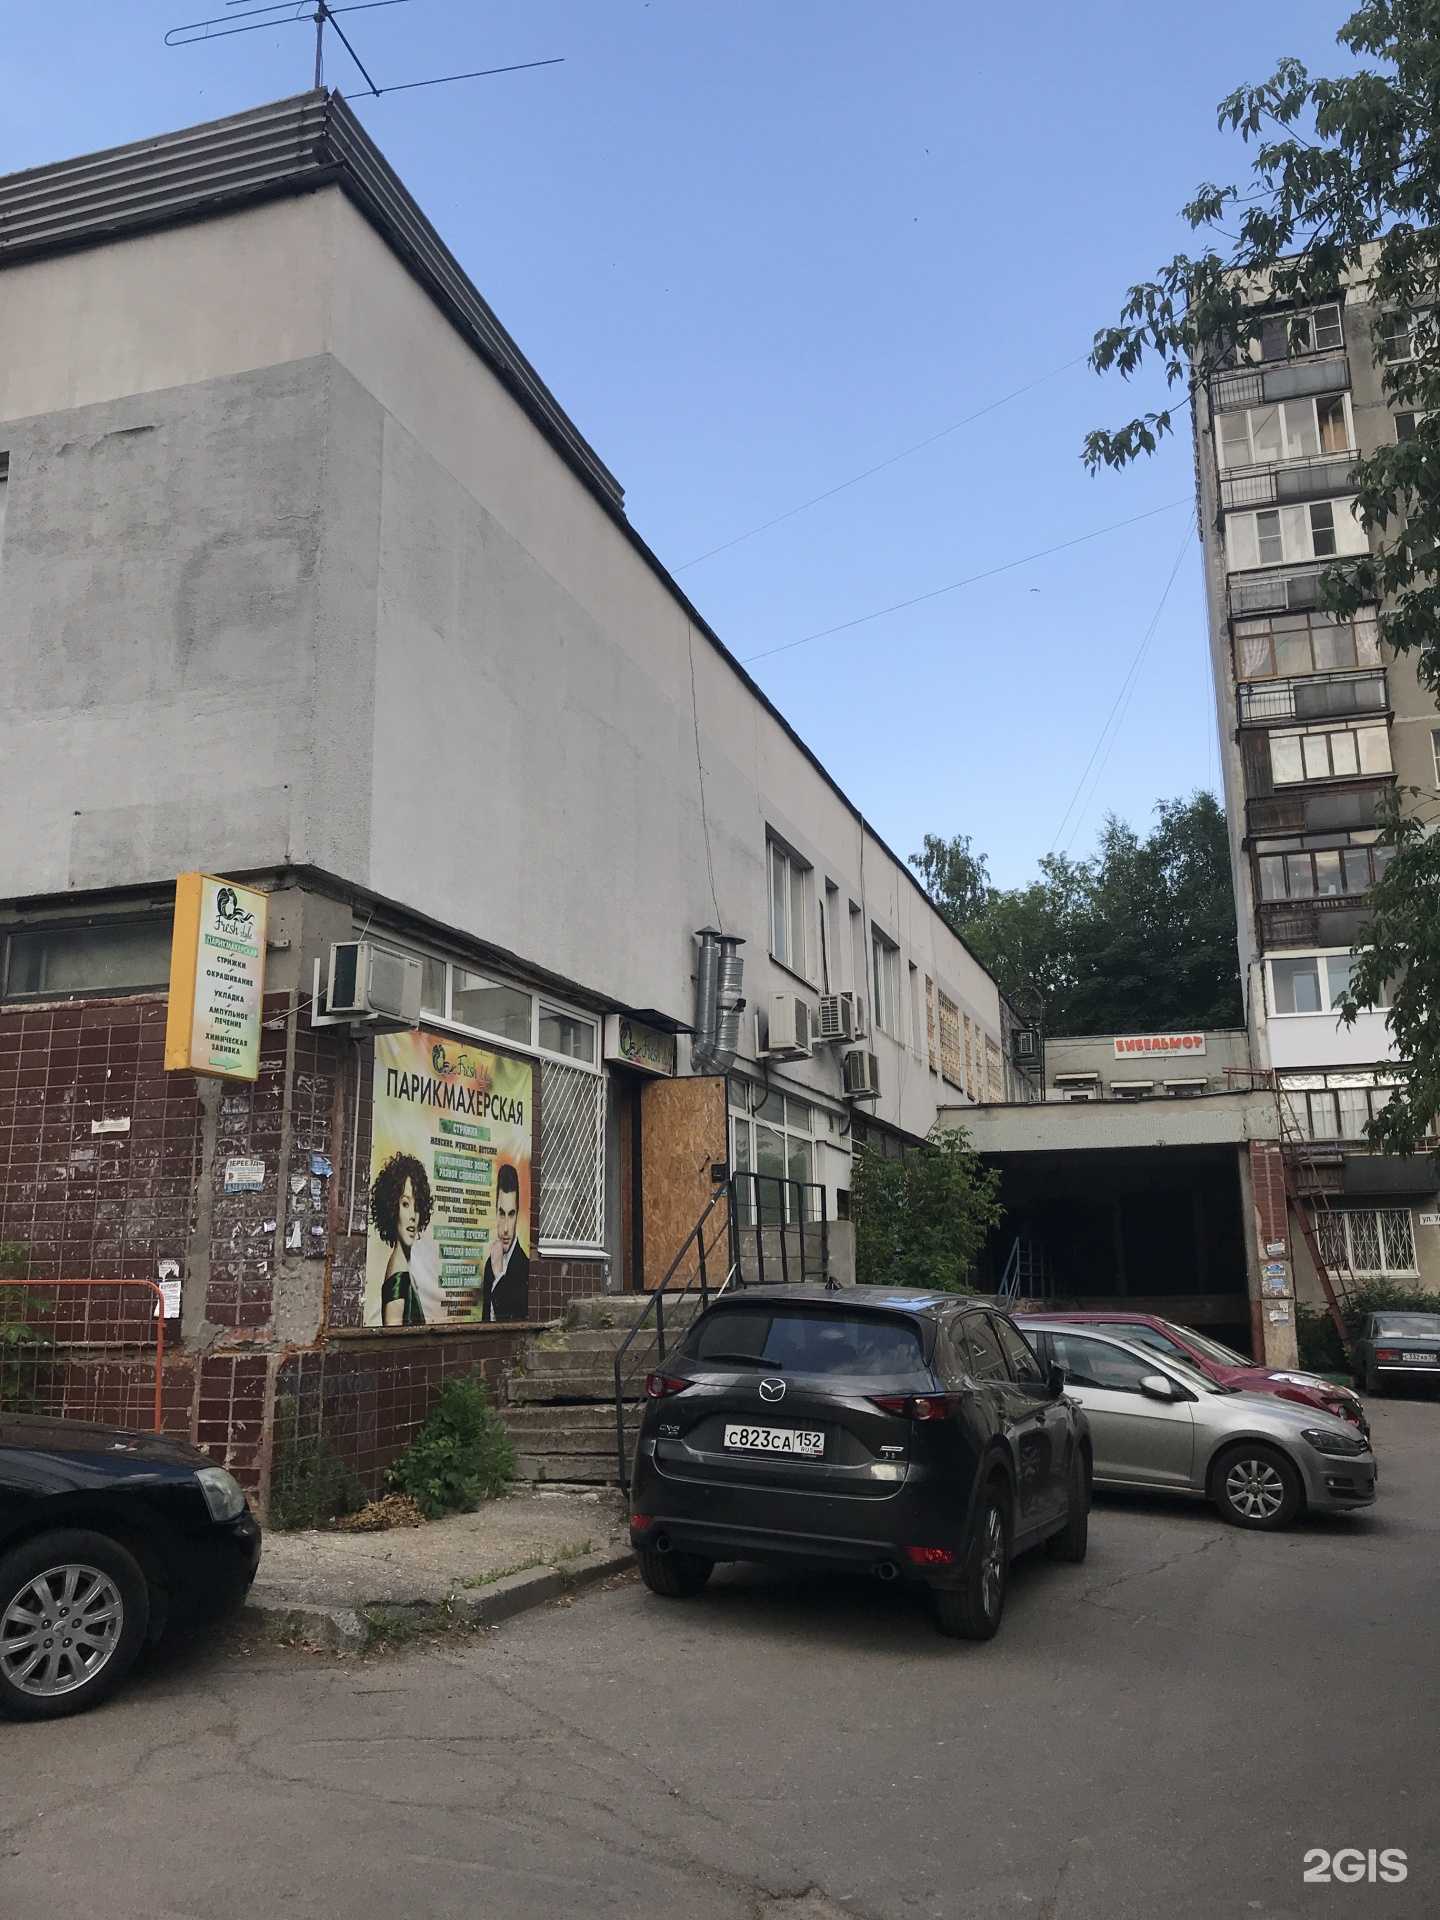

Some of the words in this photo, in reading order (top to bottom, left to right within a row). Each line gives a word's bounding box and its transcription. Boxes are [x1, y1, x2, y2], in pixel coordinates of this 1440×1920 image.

[214, 914, 238, 936] Fresh
[216, 956, 247, 970] СТРИЖКИ
[206, 969, 254, 987] ОКРАШИВАНИЕ
[214, 990, 245, 1003] УКЛАДКА
[209, 1006, 248, 1021] АМПУЛЬНОЕ
[214, 1016, 242, 1029] ЛЕЧЕНИЕ
[205, 1032, 248, 1047] ХИМИЧЕСКАЯ
[211, 1043, 241, 1056] ЗАВИВКА
[386, 1068, 524, 1126] ПАРИКМАХЕРСКАЯ
[728, 1428, 792, 1451] С823СА
[796, 1432, 821, 1448] 152
